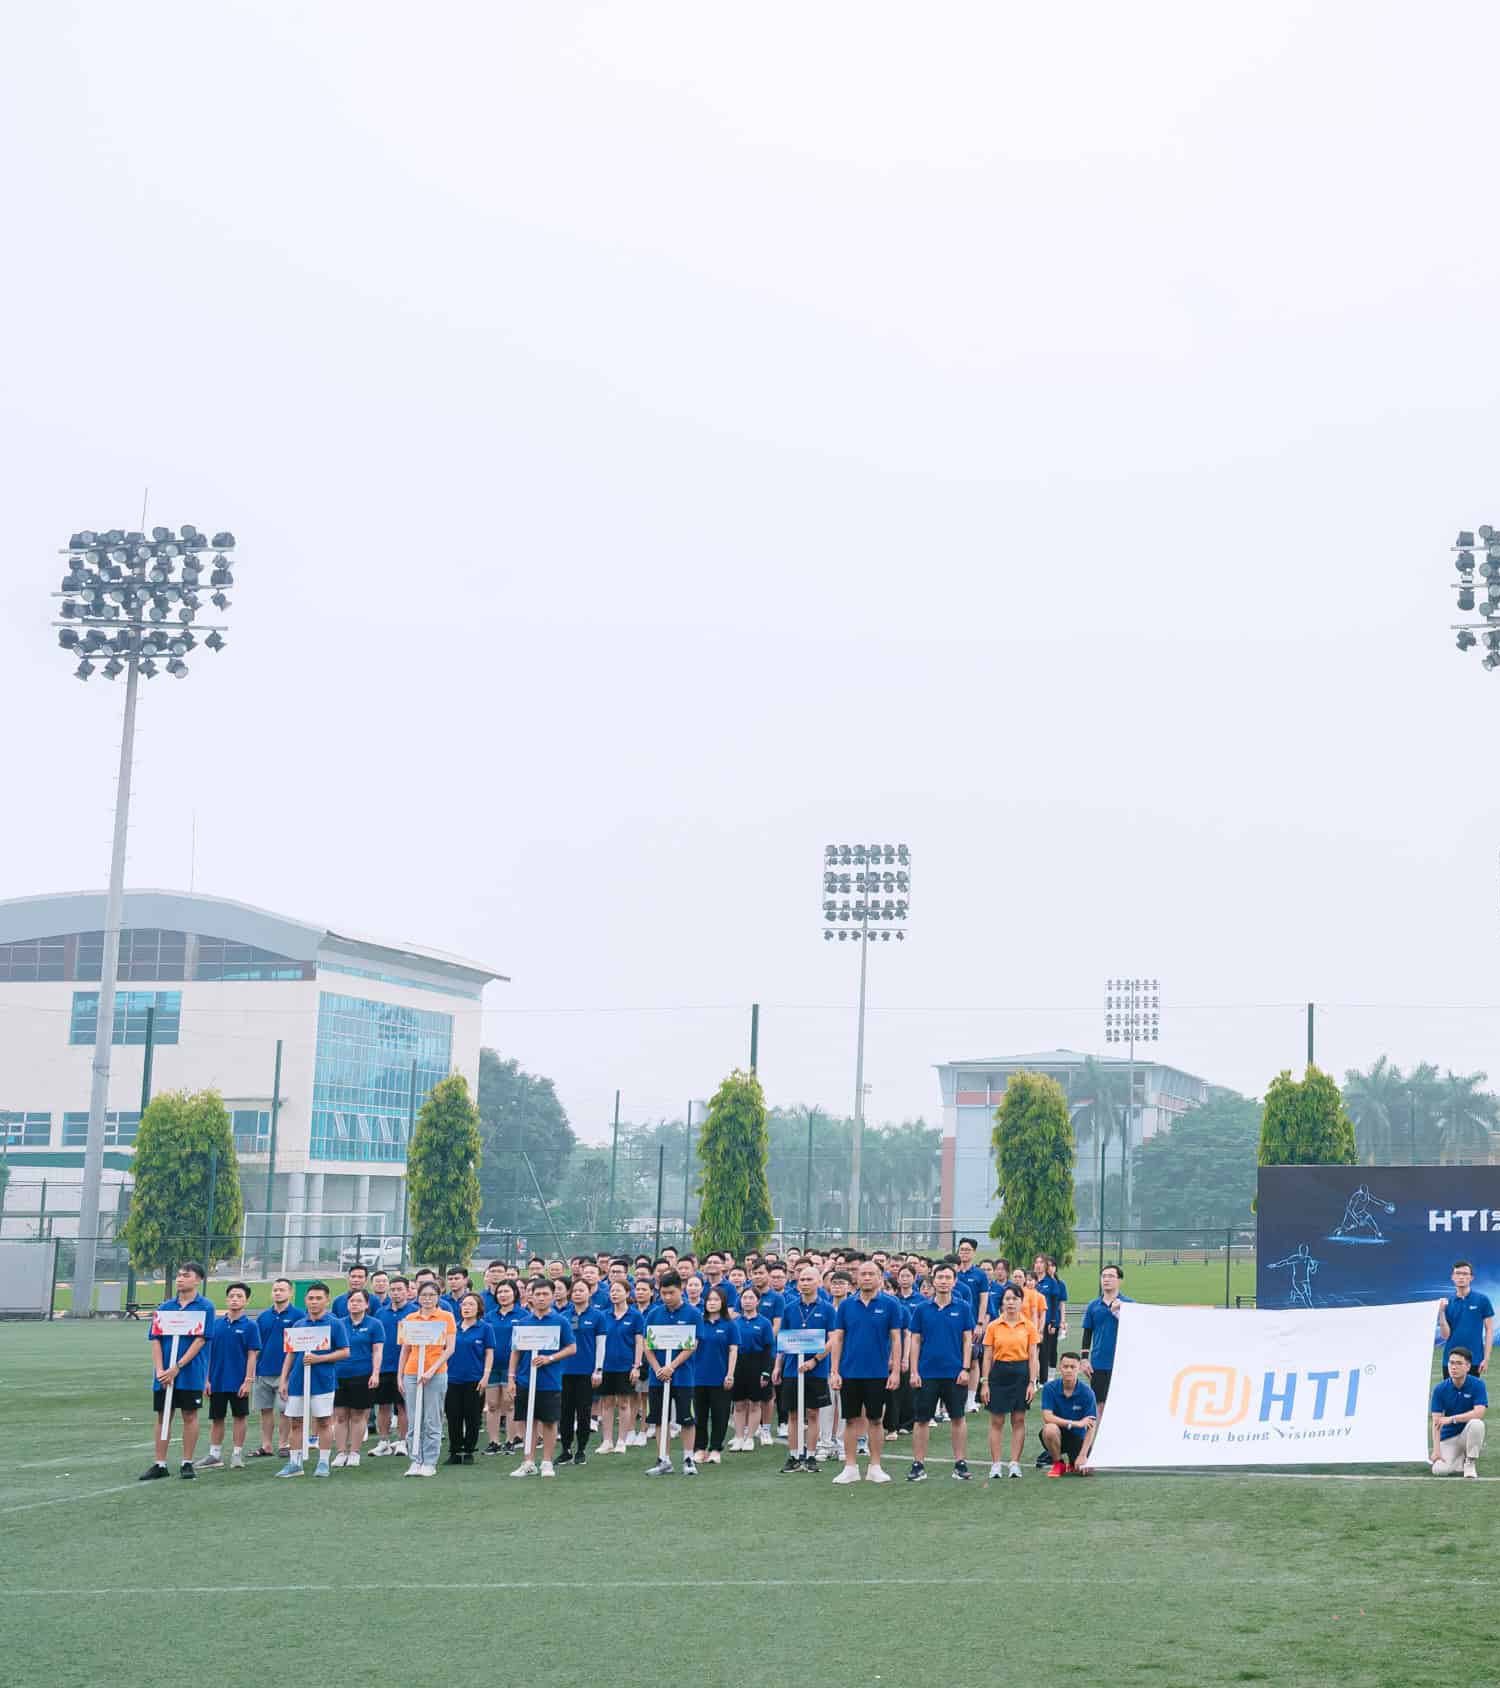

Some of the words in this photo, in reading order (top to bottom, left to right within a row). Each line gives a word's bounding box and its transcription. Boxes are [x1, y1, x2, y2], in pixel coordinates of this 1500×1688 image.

[1429, 1209, 1488, 1232] HTI
[1259, 1368, 1361, 1422] HTI
[1183, 1429, 1219, 1442] keep
[1228, 1431, 1270, 1442] being
